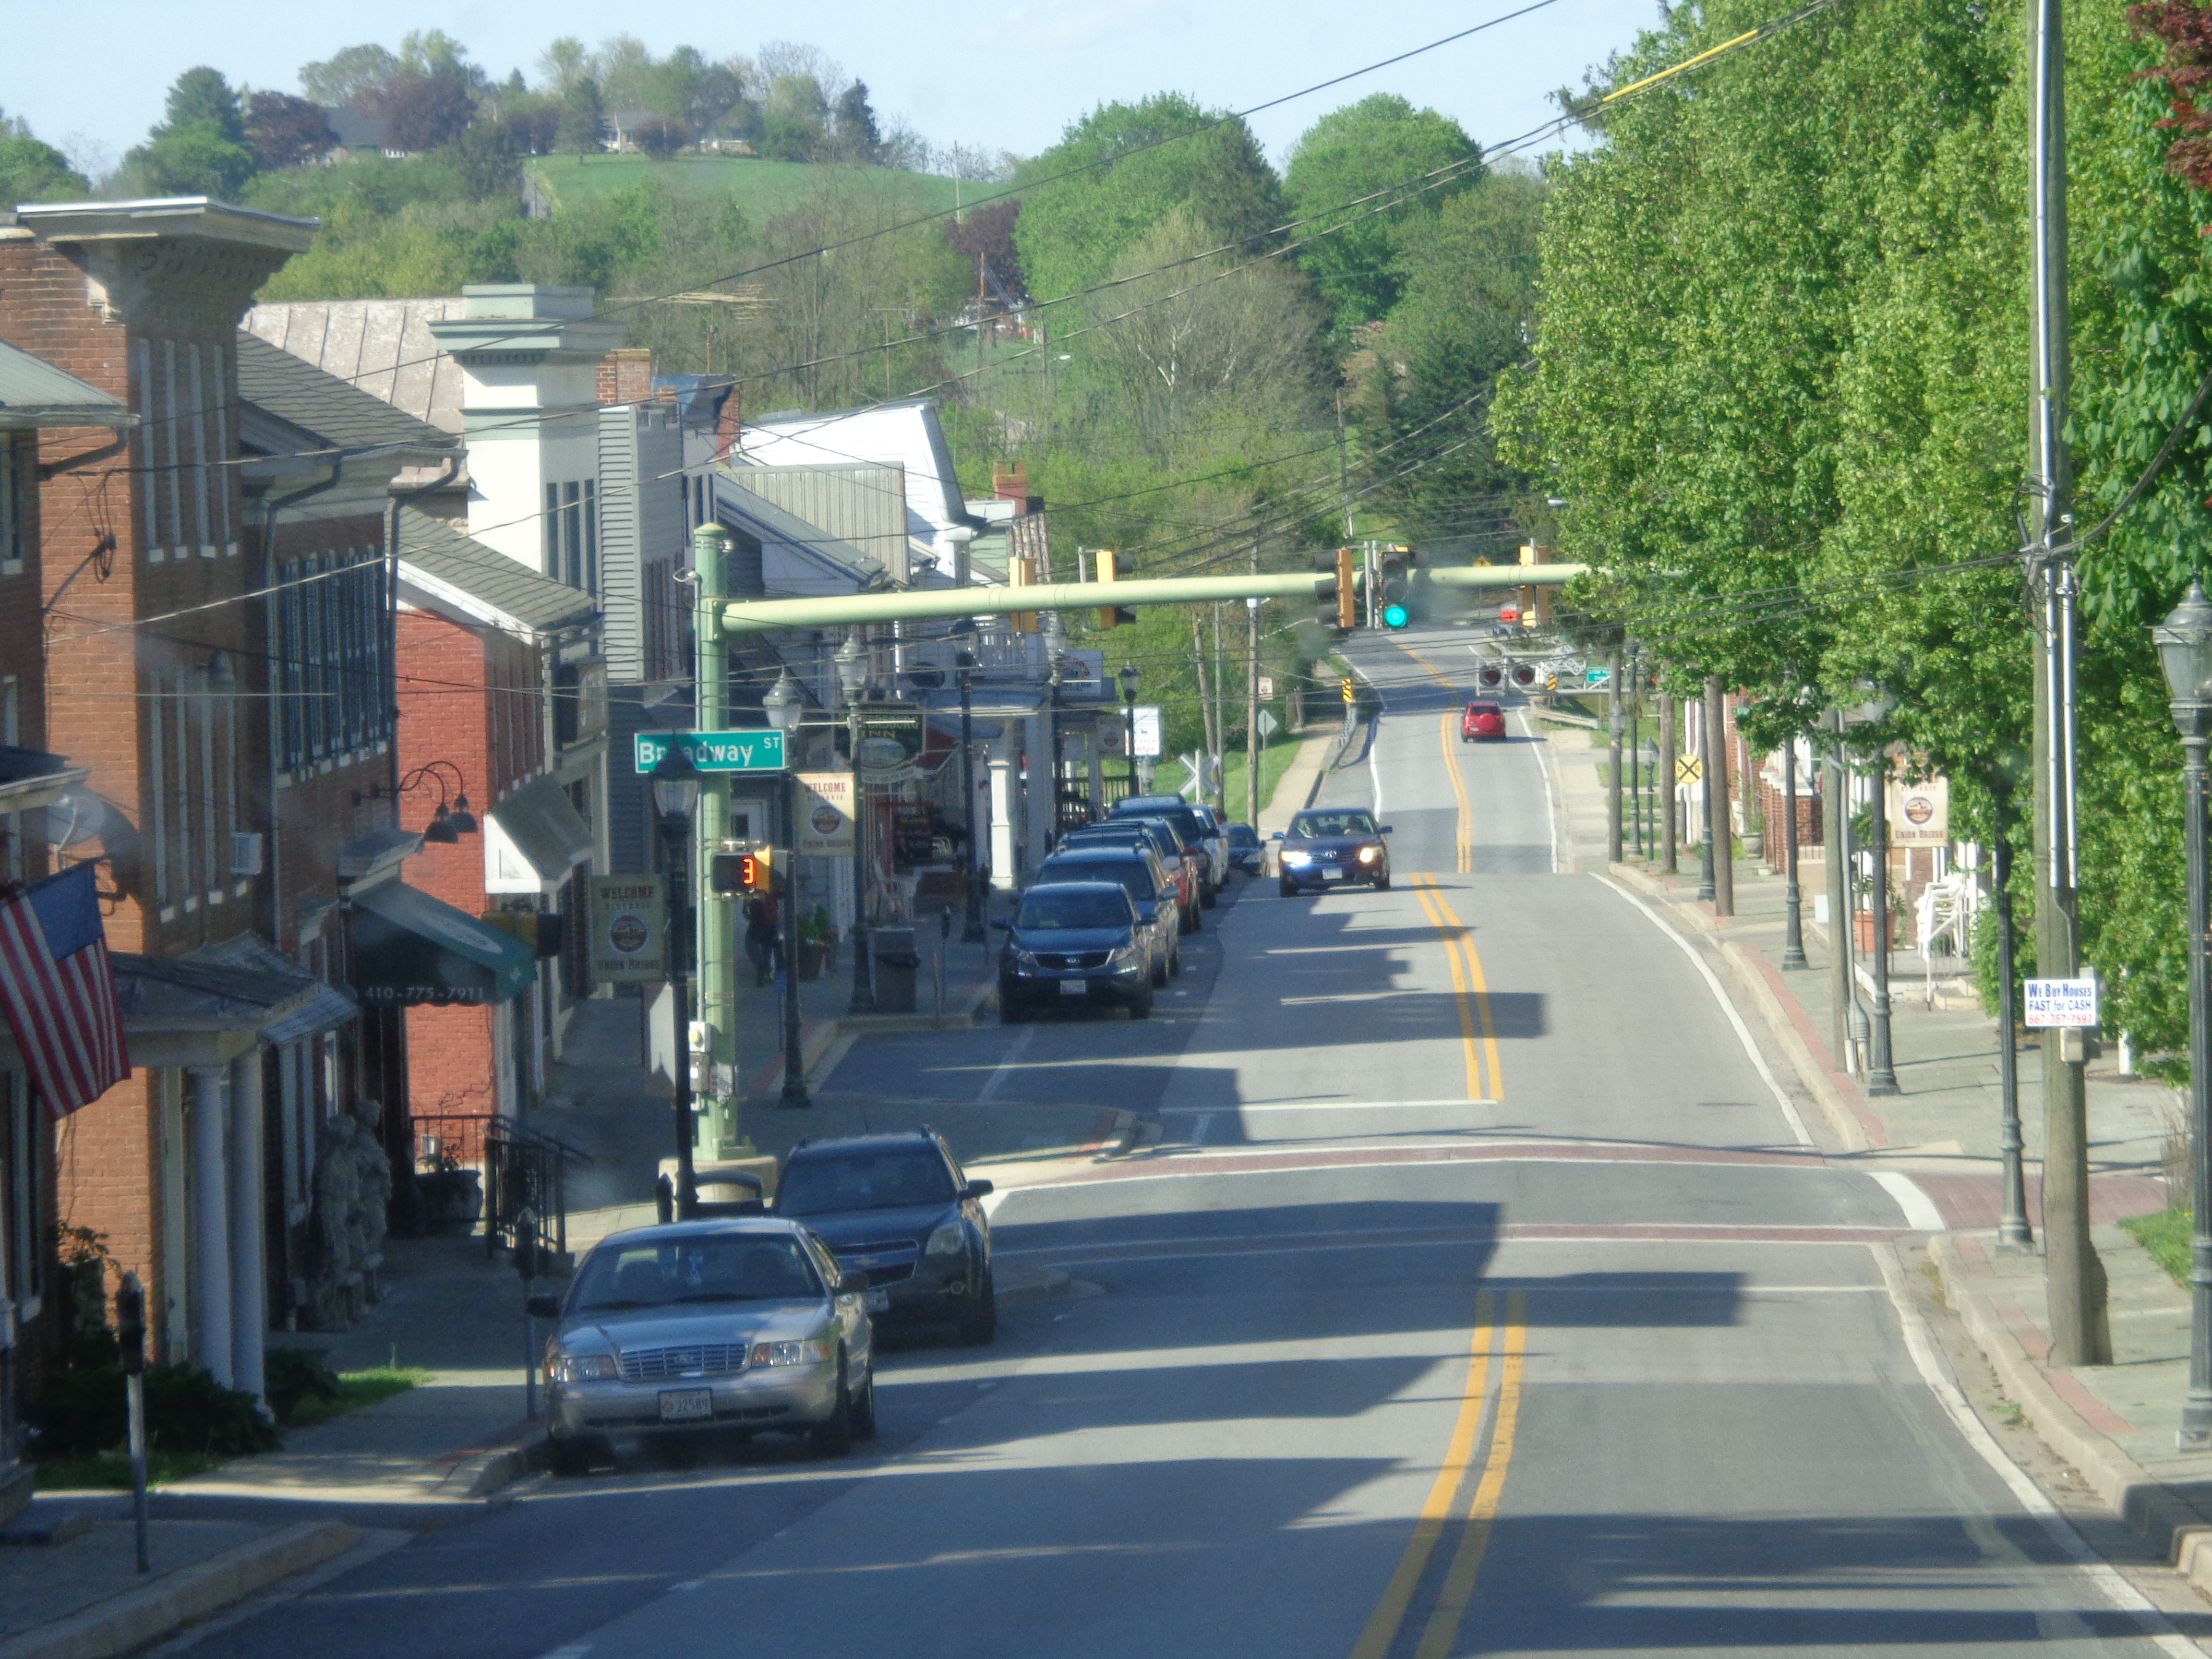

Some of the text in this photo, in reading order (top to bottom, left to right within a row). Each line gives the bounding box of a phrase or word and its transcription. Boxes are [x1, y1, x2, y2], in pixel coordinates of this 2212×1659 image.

[639, 736, 780, 767] Bradway ST
[805, 782, 846, 793] WELCOME
[1896, 830, 1944, 839] UNION BRIDGE
[743, 858, 754, 884] 3
[601, 886, 653, 899] WELCOME
[2029, 1000, 2092, 1011] FAST for CASH
